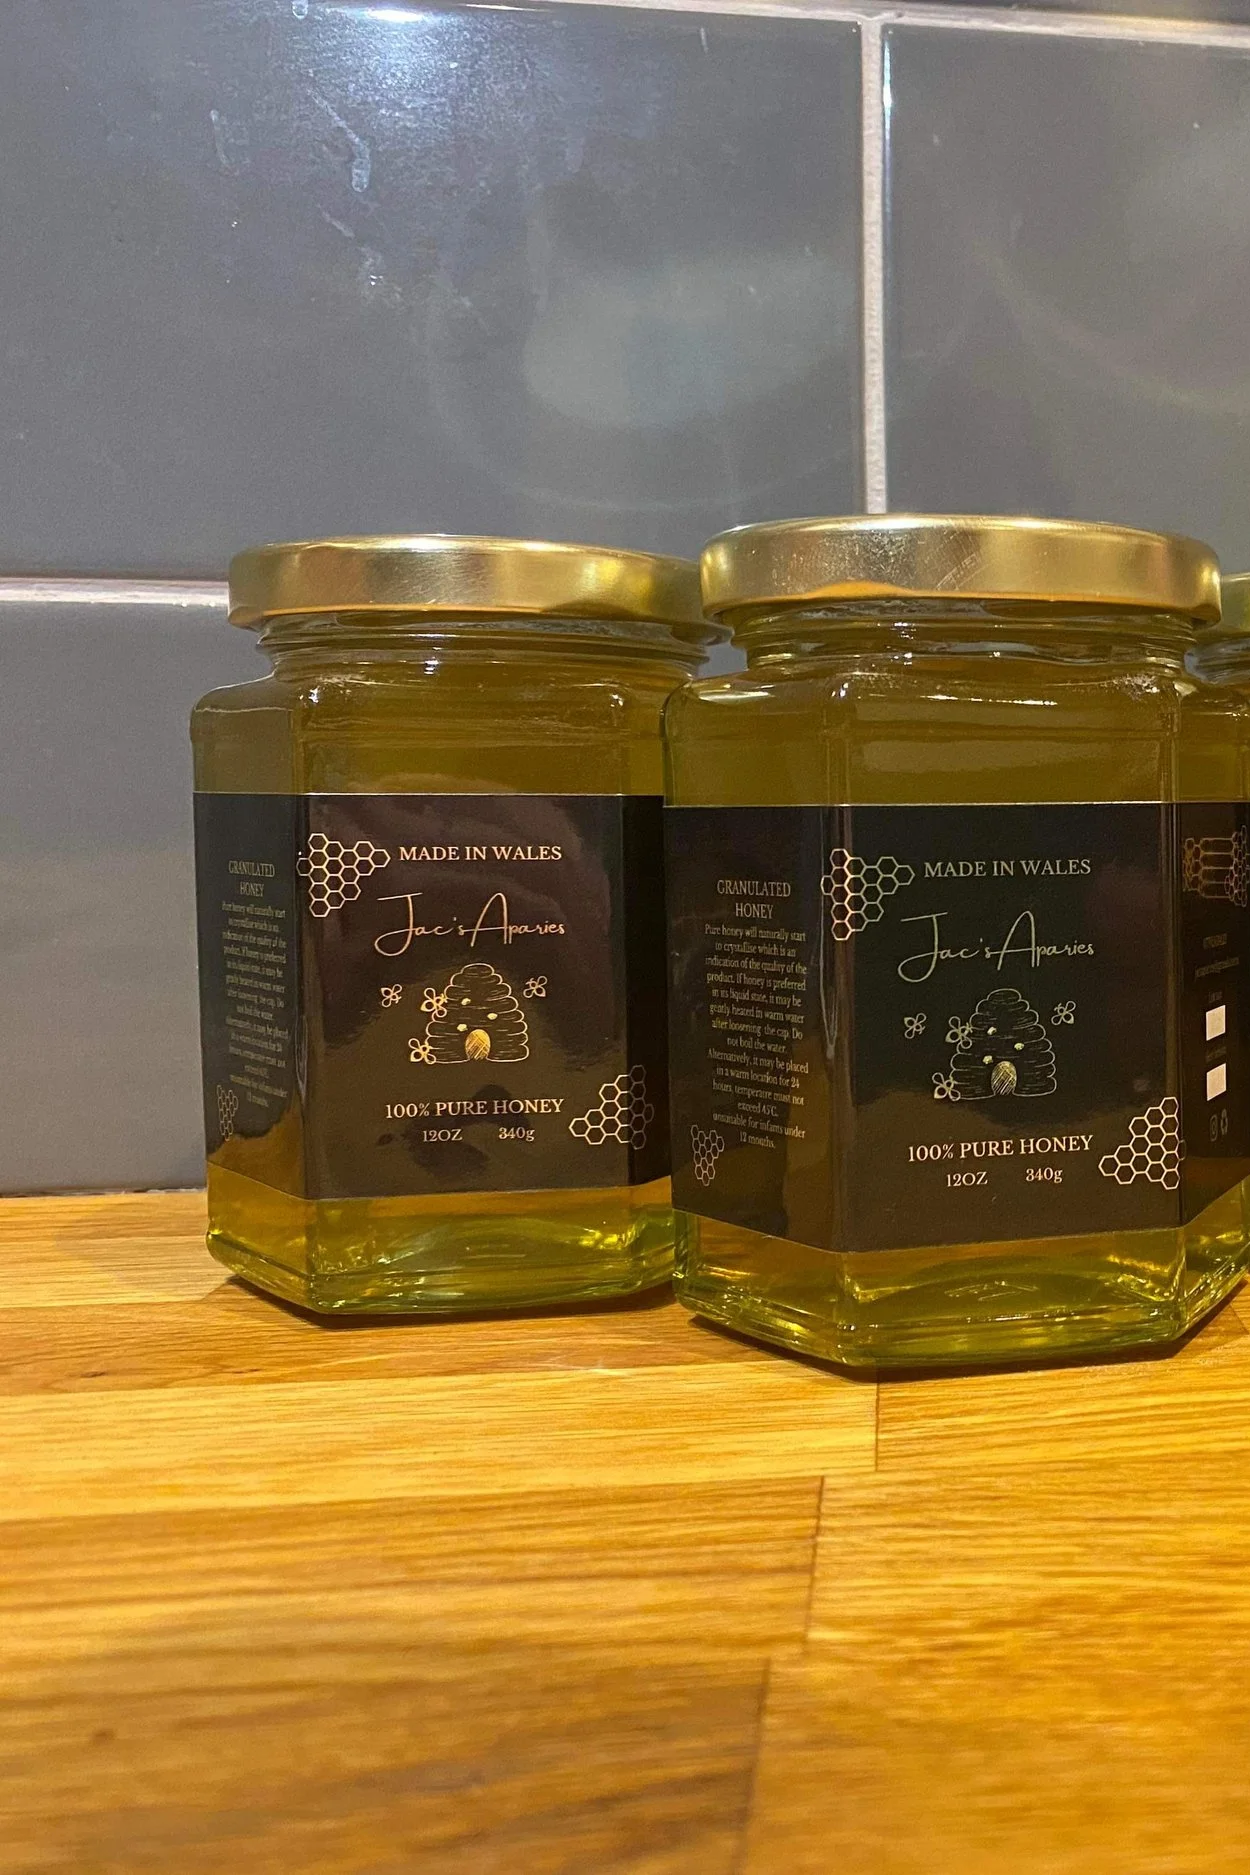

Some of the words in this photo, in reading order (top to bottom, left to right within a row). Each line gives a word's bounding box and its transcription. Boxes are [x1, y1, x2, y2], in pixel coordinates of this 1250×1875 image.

[399, 846, 460, 861] MADE
[464, 846, 487, 861] IN
[491, 845, 562, 861] WALES
[229, 860, 275, 877] GRANULATED
[924, 861, 987, 878] MADE
[992, 860, 1015, 876] IN
[1019, 858, 1091, 876] WALES
[240, 881, 264, 897] HONEY
[717, 880, 791, 897] GRANULATED
[735, 903, 773, 919] HONEY
[374, 892, 465, 957] Jac's
[470, 892, 565, 947] Aparies
[705, 923, 721, 935] Pure
[722, 924, 743, 939] honey
[745, 926, 757, 937] will
[758, 943, 779, 956] which
[898, 911, 990, 982] Jac's
[996, 910, 1095, 972] Aparies
[740, 957, 748, 968] of
[749, 958, 760, 969] the
[786, 963, 794, 973] of
[795, 962, 807, 974] the
[743, 974, 765, 989] honey
[773, 977, 806, 991] preferred
[776, 996, 791, 1008] may
[792, 995, 802, 1007] be
[792, 1027, 803, 1039] Do
[759, 1058, 774, 1069] may
[775, 1056, 785, 1069] be
[786, 1060, 809, 1074] placed
[730, 1069, 750, 1079] warm
[779, 1075, 790, 1086] for
[791, 1076, 800, 1088] 24
[386, 1102, 430, 1119] 100%
[435, 1100, 488, 1116] PURE
[493, 1098, 565, 1115] HONEY
[422, 1128, 462, 1142] 12OZ
[498, 1127, 536, 1142] 340g
[784, 1125, 806, 1138] under
[908, 1143, 954, 1162] 100%
[959, 1139, 1014, 1159] PURE
[1019, 1134, 1094, 1155] HONEY
[947, 1171, 988, 1187] 12OZ
[1025, 1167, 1063, 1184] 340g
